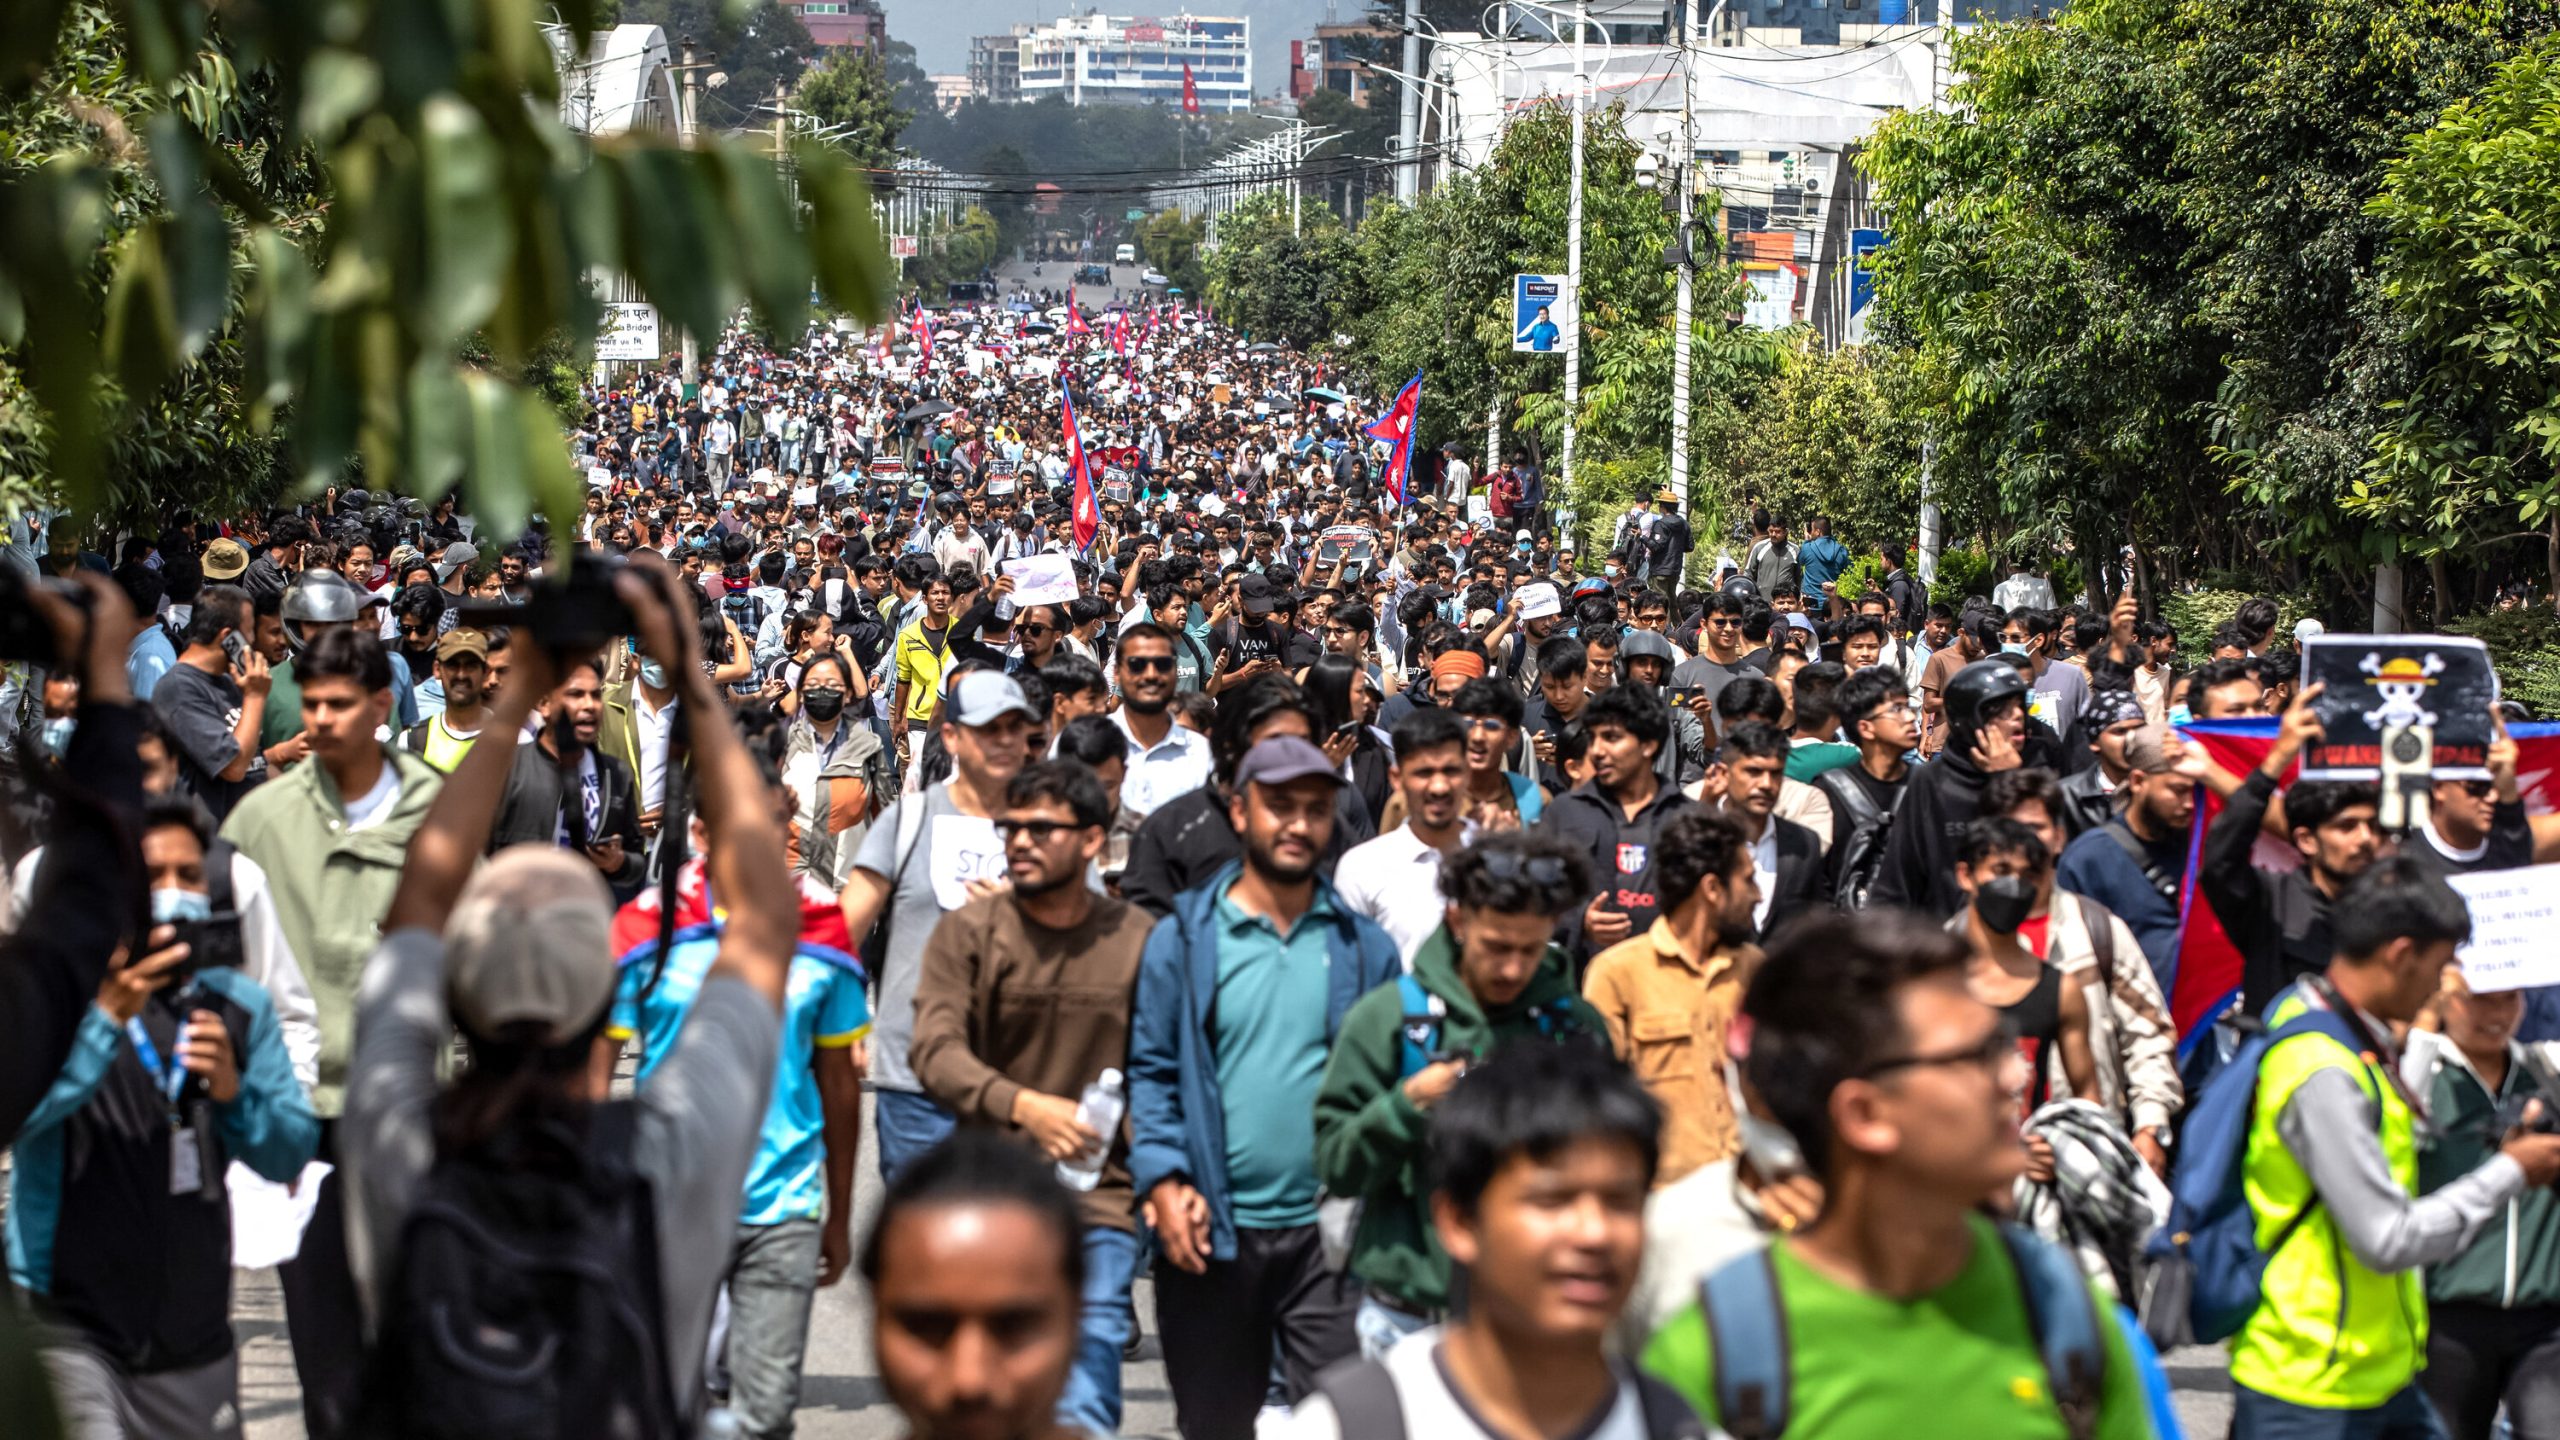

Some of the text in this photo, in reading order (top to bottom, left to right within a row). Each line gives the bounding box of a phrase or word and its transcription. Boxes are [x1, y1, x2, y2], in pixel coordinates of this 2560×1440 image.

[627, 324, 653, 333] Bridge
[1240, 639, 1268, 650] VAN
[1945, 821, 1969, 837] ES
[1616, 888, 1655, 909] Spo
